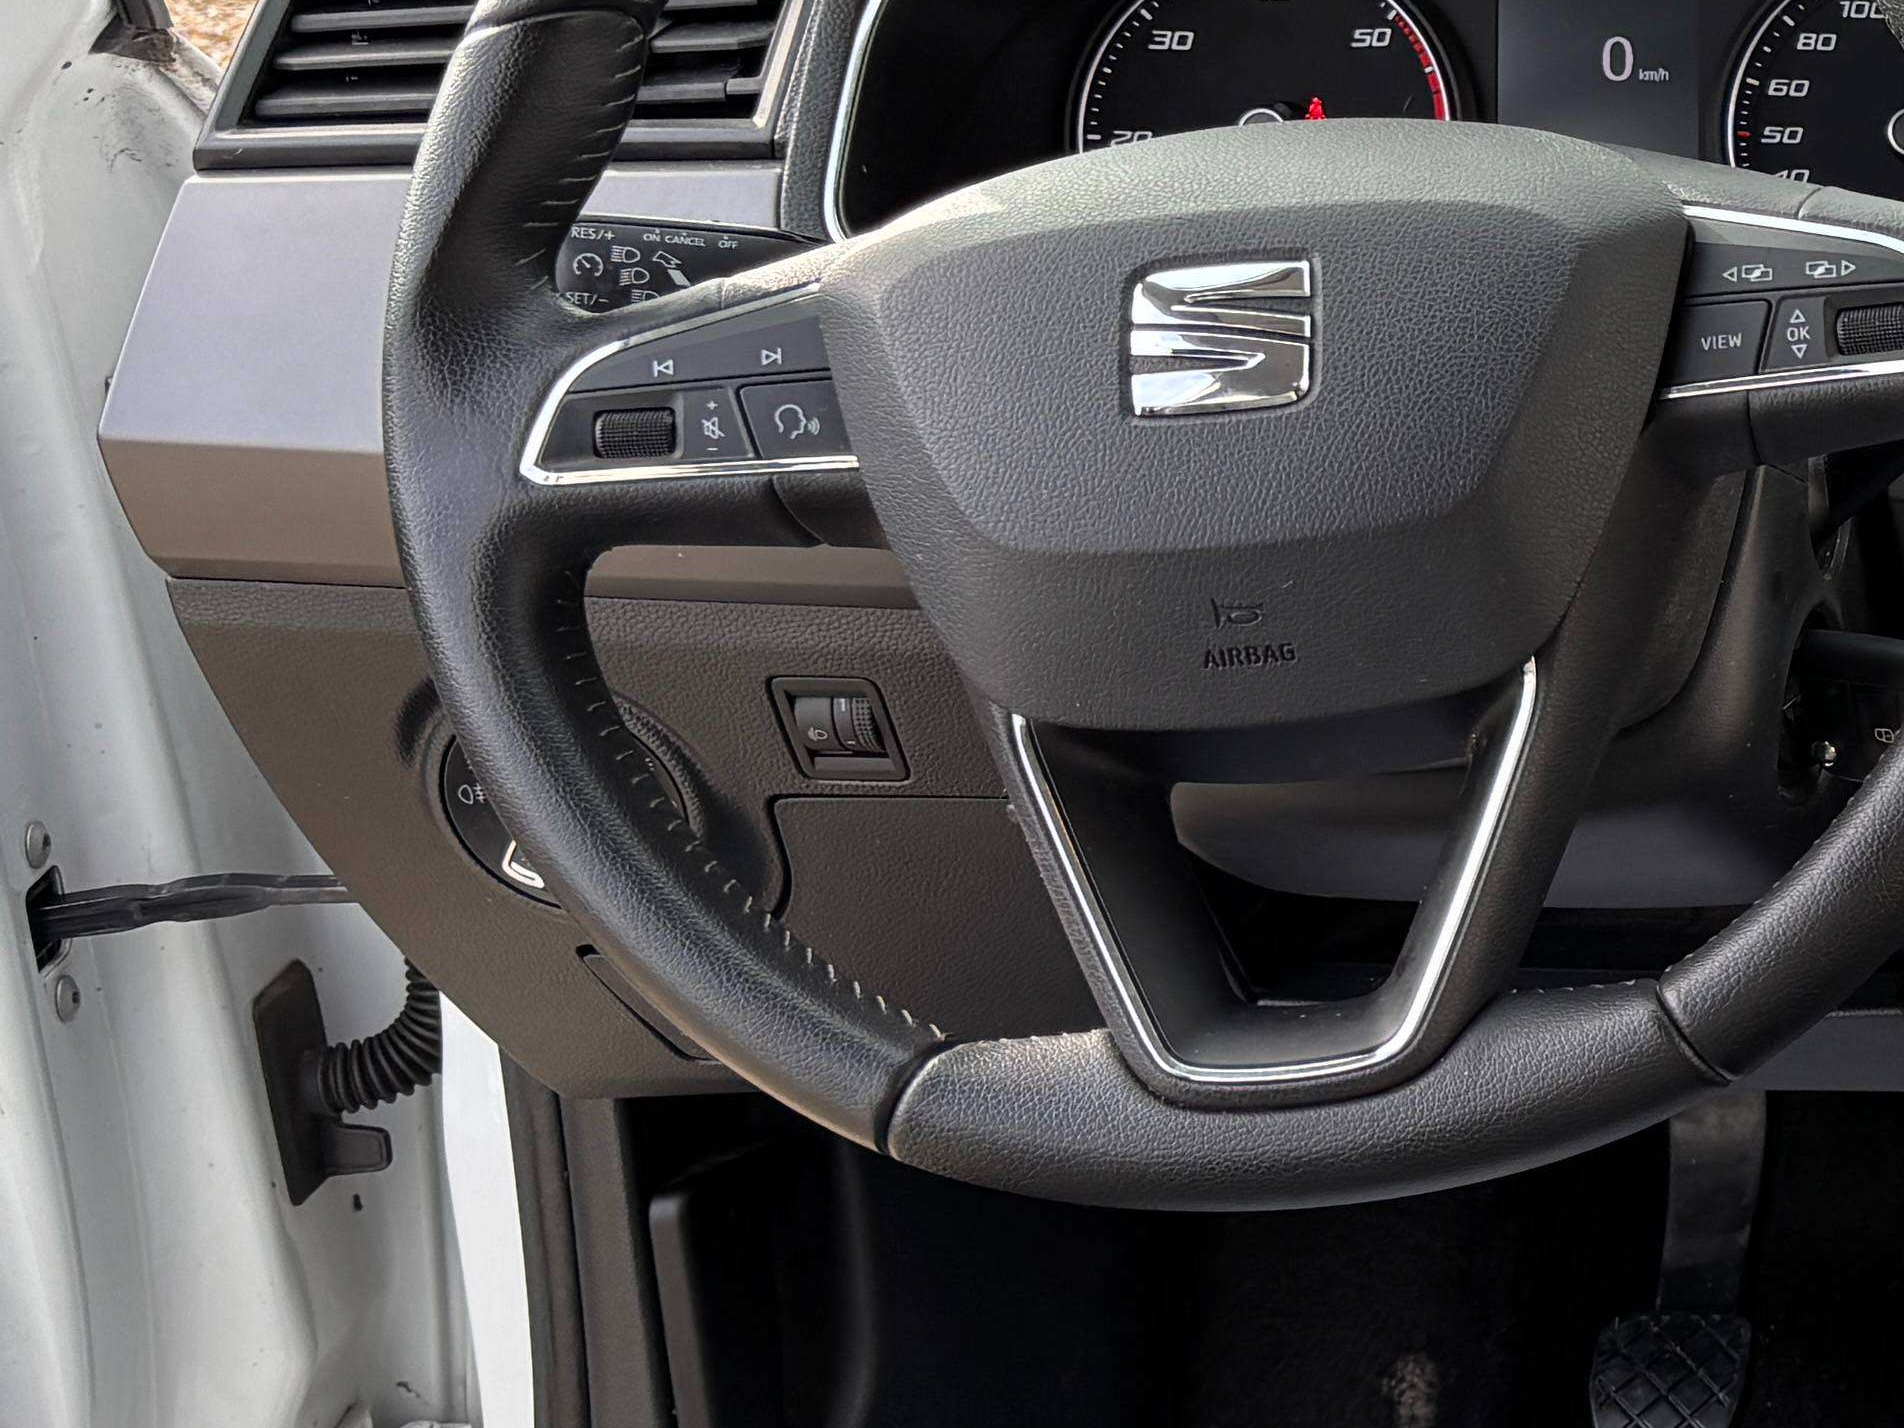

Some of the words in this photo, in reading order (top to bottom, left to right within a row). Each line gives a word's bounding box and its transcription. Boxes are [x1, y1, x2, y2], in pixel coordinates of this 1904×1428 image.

[1148, 30, 1195, 51] 30
[1350, 27, 1392, 48] 50
[1796, 33, 1837, 51] 80
[1602, 36, 1634, 82] 0
[1767, 79, 1810, 97] 60
[1760, 126, 1804, 144] 50
[664, 234, 706, 247] CANCEL
[718, 239, 739, 249] OFF
[1700, 332, 1742, 351] VIEW
[1786, 325, 1811, 342] OK
[1203, 641, 1297, 670] AIRBAG
